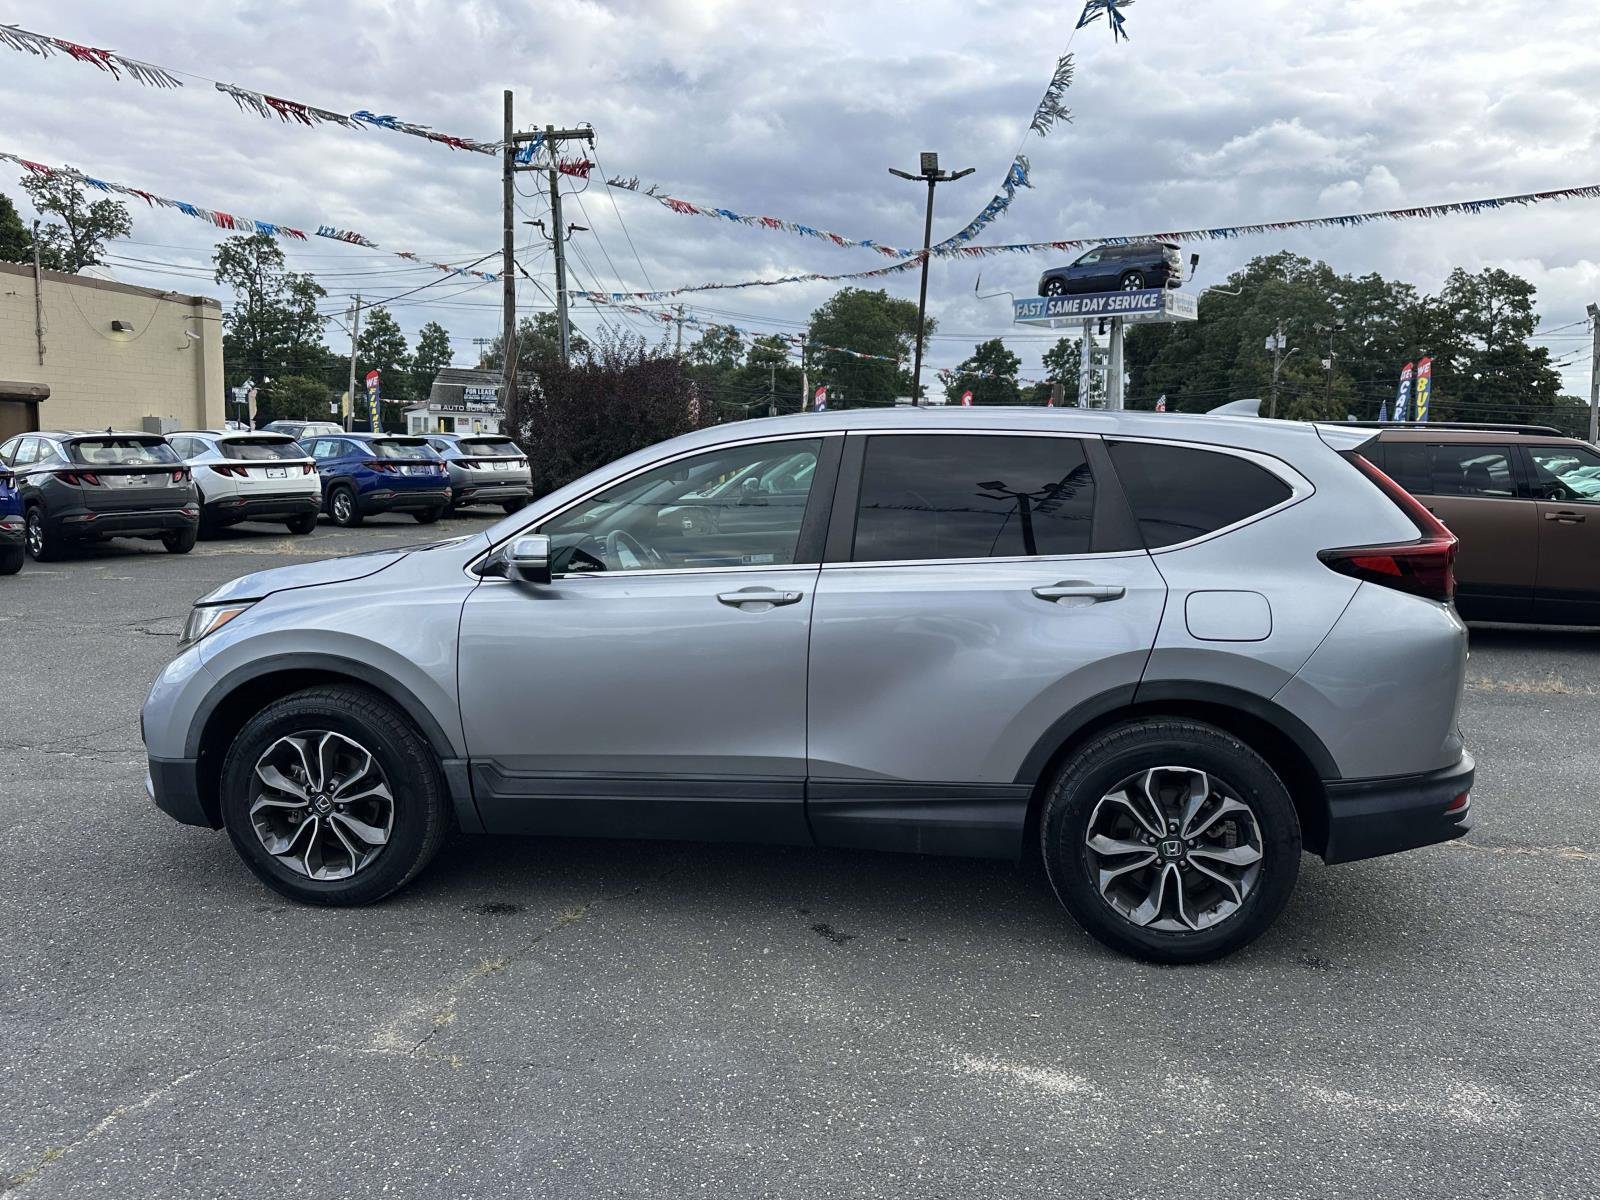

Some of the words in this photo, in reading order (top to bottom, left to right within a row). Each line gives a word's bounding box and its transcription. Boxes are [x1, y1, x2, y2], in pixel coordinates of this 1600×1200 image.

[1015, 301, 1044, 317] FAST
[1047, 299, 1080, 315] SAME
[1081, 296, 1107, 312] DAY
[1108, 293, 1159, 311] SERVICE
[1417, 361, 1431, 377] WE
[366, 376, 379, 389] WE
[478, 388, 496, 396] LEASE
[1416, 377, 1429, 421] BUY
[368, 387, 380, 433] FINANCE
